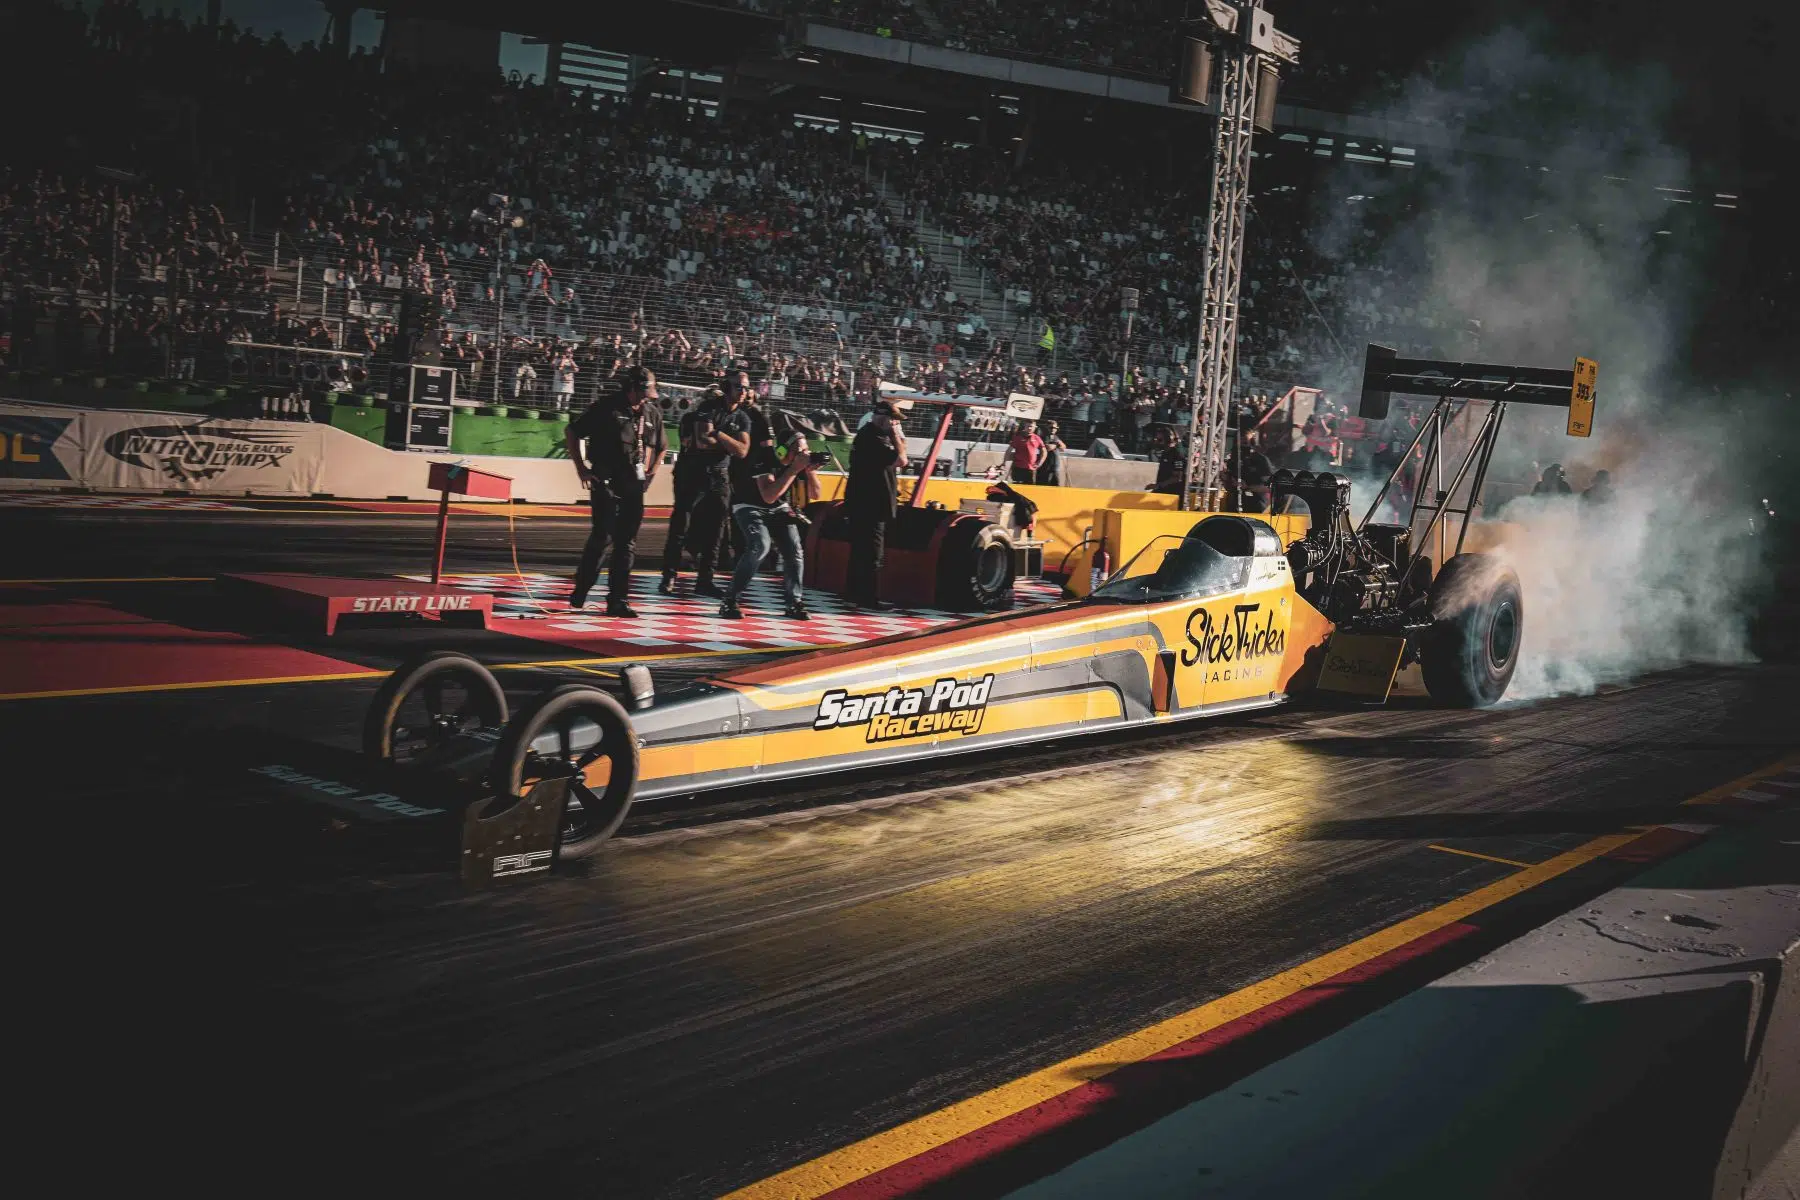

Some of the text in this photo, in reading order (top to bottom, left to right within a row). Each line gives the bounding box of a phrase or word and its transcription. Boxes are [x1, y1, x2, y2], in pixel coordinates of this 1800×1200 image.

[1576, 361, 1585, 375] TF
[215, 443, 295, 454] DRAG RACING
[353, 595, 472, 613] START LINE
[813, 672, 995, 731] Santa Pod
[866, 707, 987, 743] Raceway
[350, 792, 448, 817] Pod
